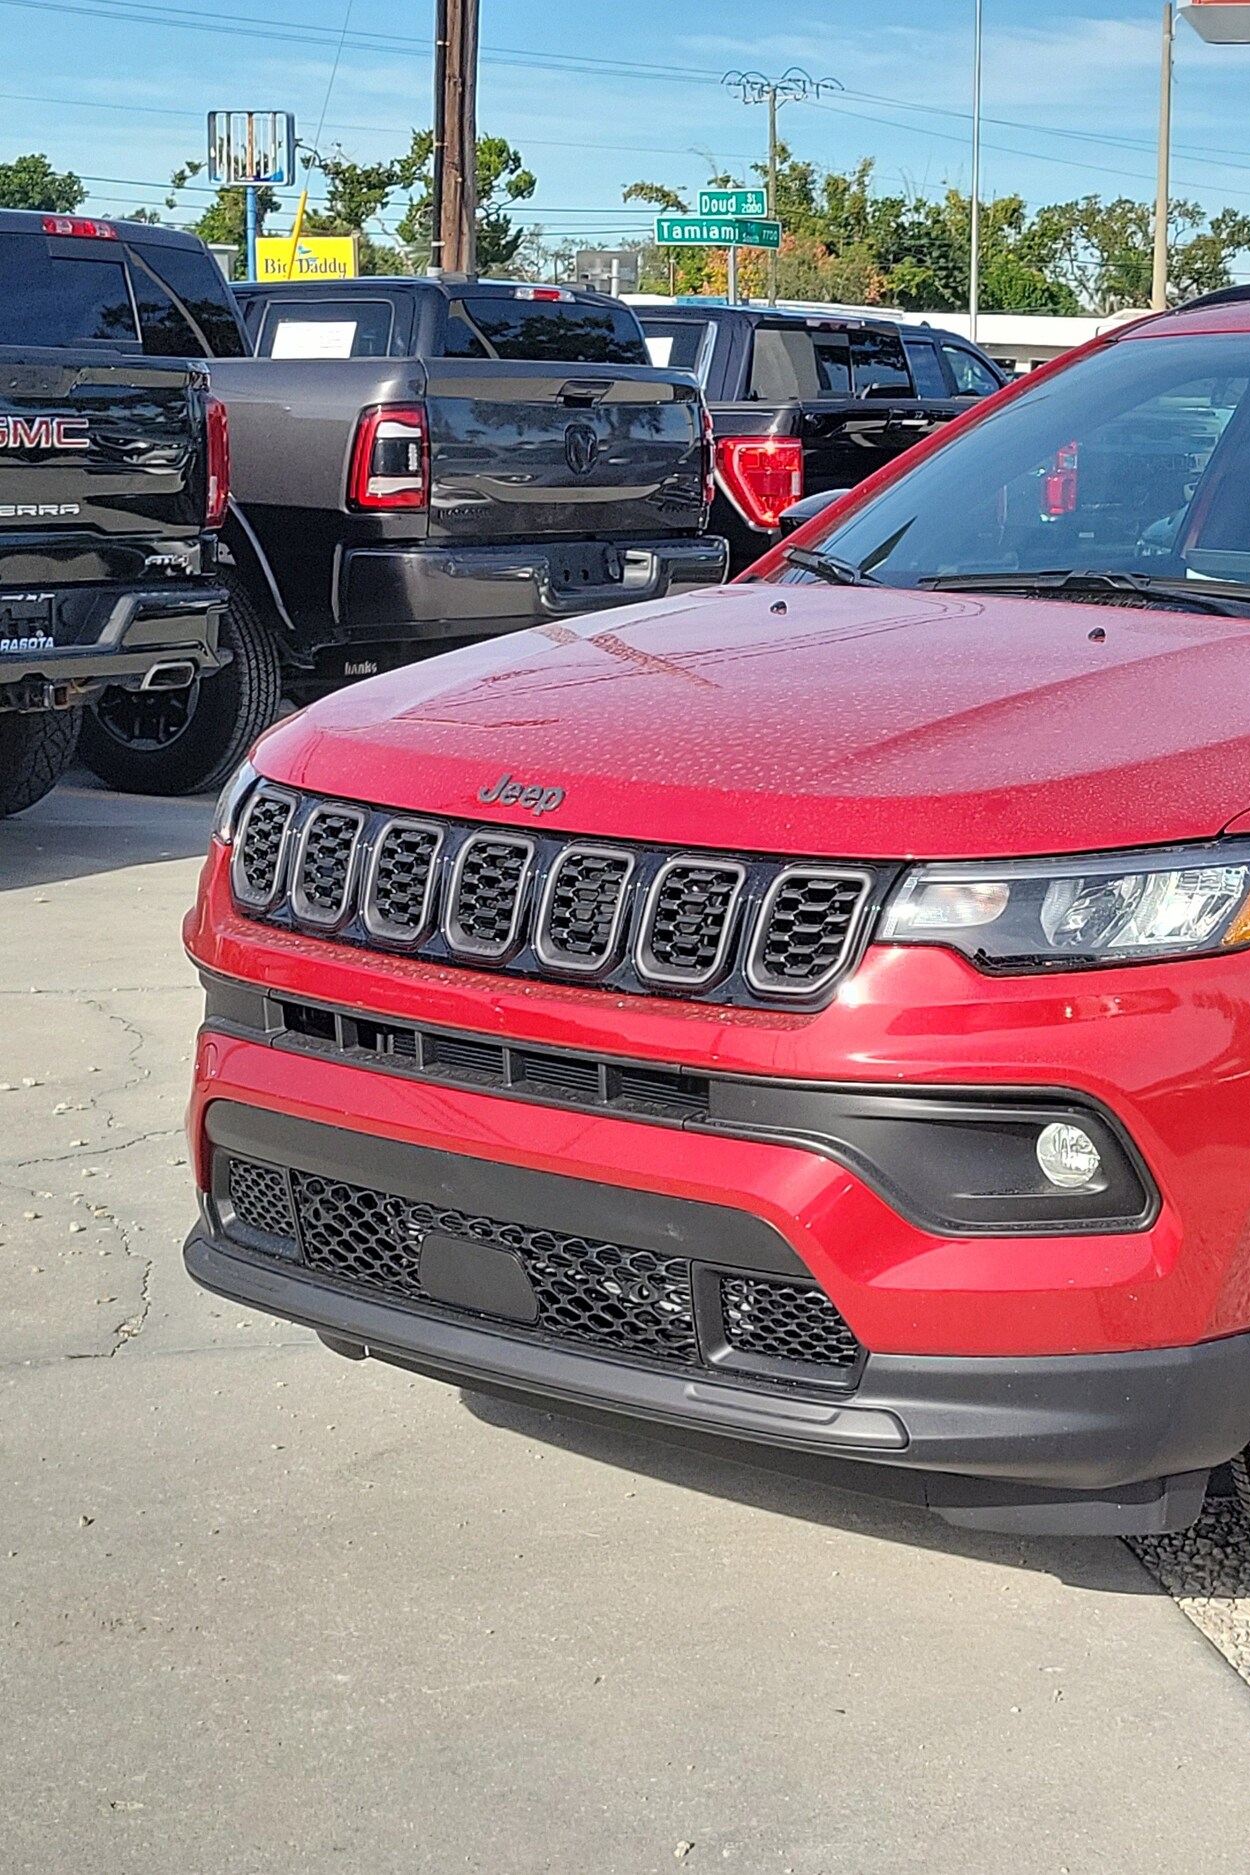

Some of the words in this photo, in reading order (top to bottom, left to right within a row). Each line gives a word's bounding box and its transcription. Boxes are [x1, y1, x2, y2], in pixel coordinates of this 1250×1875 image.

[701, 195, 737, 213] Doud
[746, 192, 756, 204] St
[741, 203, 763, 214] 2000
[660, 221, 739, 240] Tamiami
[298, 257, 347, 279] Daddy
[0, 416, 90, 449] MC
[344, 660, 378, 676] banks
[479, 773, 566, 817] Jeep
